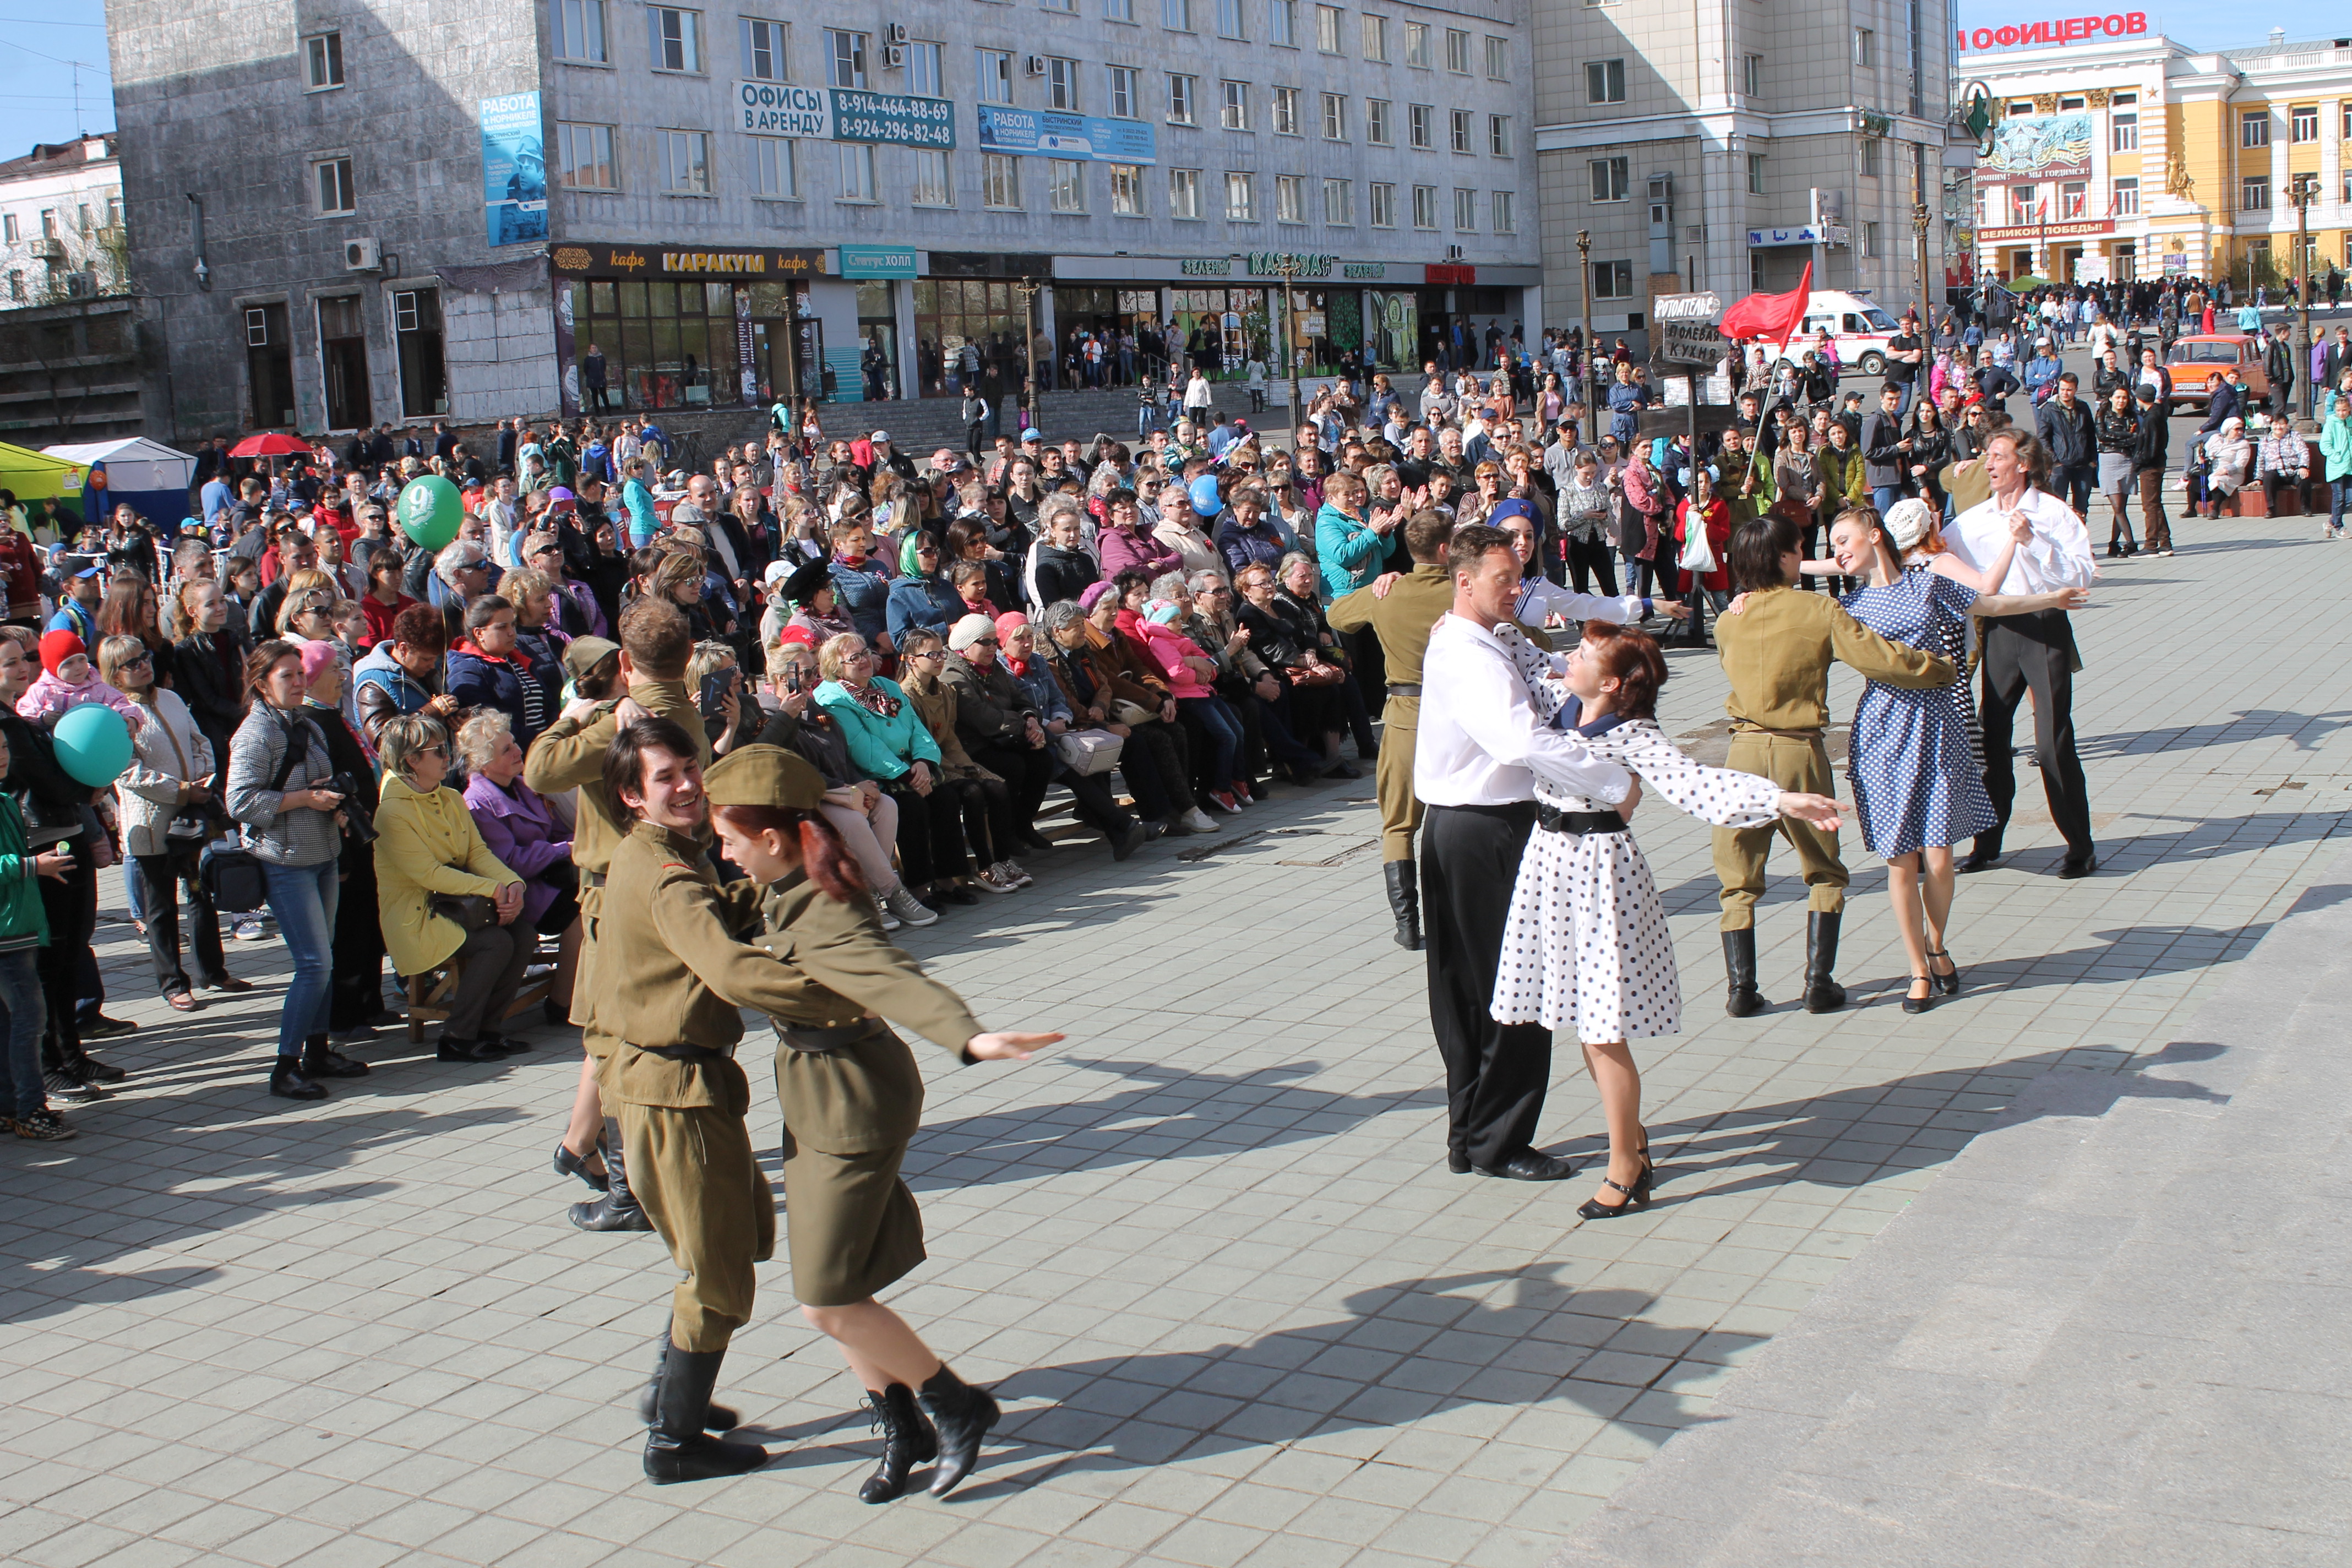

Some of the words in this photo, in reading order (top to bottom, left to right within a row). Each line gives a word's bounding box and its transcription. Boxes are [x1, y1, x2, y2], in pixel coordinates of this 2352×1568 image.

[1972, 12, 2147, 50] ОФИЦЕРОВ
[482, 94, 536, 115] РАБОТА
[742, 84, 823, 112] ОФИСЫ
[838, 93, 948, 121] 8-914-464-88-69
[484, 123, 511, 132] ВАХТОВЫМ
[512, 120, 537, 128] МЕТОДОМ
[490, 110, 537, 124] НОРНИКЕЛЕ
[745, 110, 754, 128] В
[758, 111, 824, 135] АРЕНДУ
[994, 112, 1035, 129] РАБОТА
[1042, 116, 1082, 126] БЫСТРИНСКИЙ
[485, 130, 520, 140] БЫСТРИНСКИЙ
[841, 117, 950, 144] 8-924-296-82-48
[1000, 128, 1036, 139] НОРНИКЕЛЕ
[1975, 173, 2011, 183] ОМНИМ!
[2028, 171, 2042, 179] МЫ
[1981, 226, 2040, 239] ВЕЛИКОЙ
[2044, 223, 2103, 236] ПОБЕДЫ!
[611, 250, 646, 272] кафе
[663, 253, 765, 273] КАРАКУМ
[778, 254, 808, 275] кафе
[848, 254, 884, 269] Статус
[885, 255, 911, 266] ХОЛЛ
[1655, 296, 1713, 318] ФОТОАТЕЛЬЕ
[1302, 320, 1309, 333] 99
[1669, 324, 1720, 342] ПОЛЕВАЯ
[1670, 342, 1716, 360] КУХНЯ
[410, 485, 428, 511] 9
